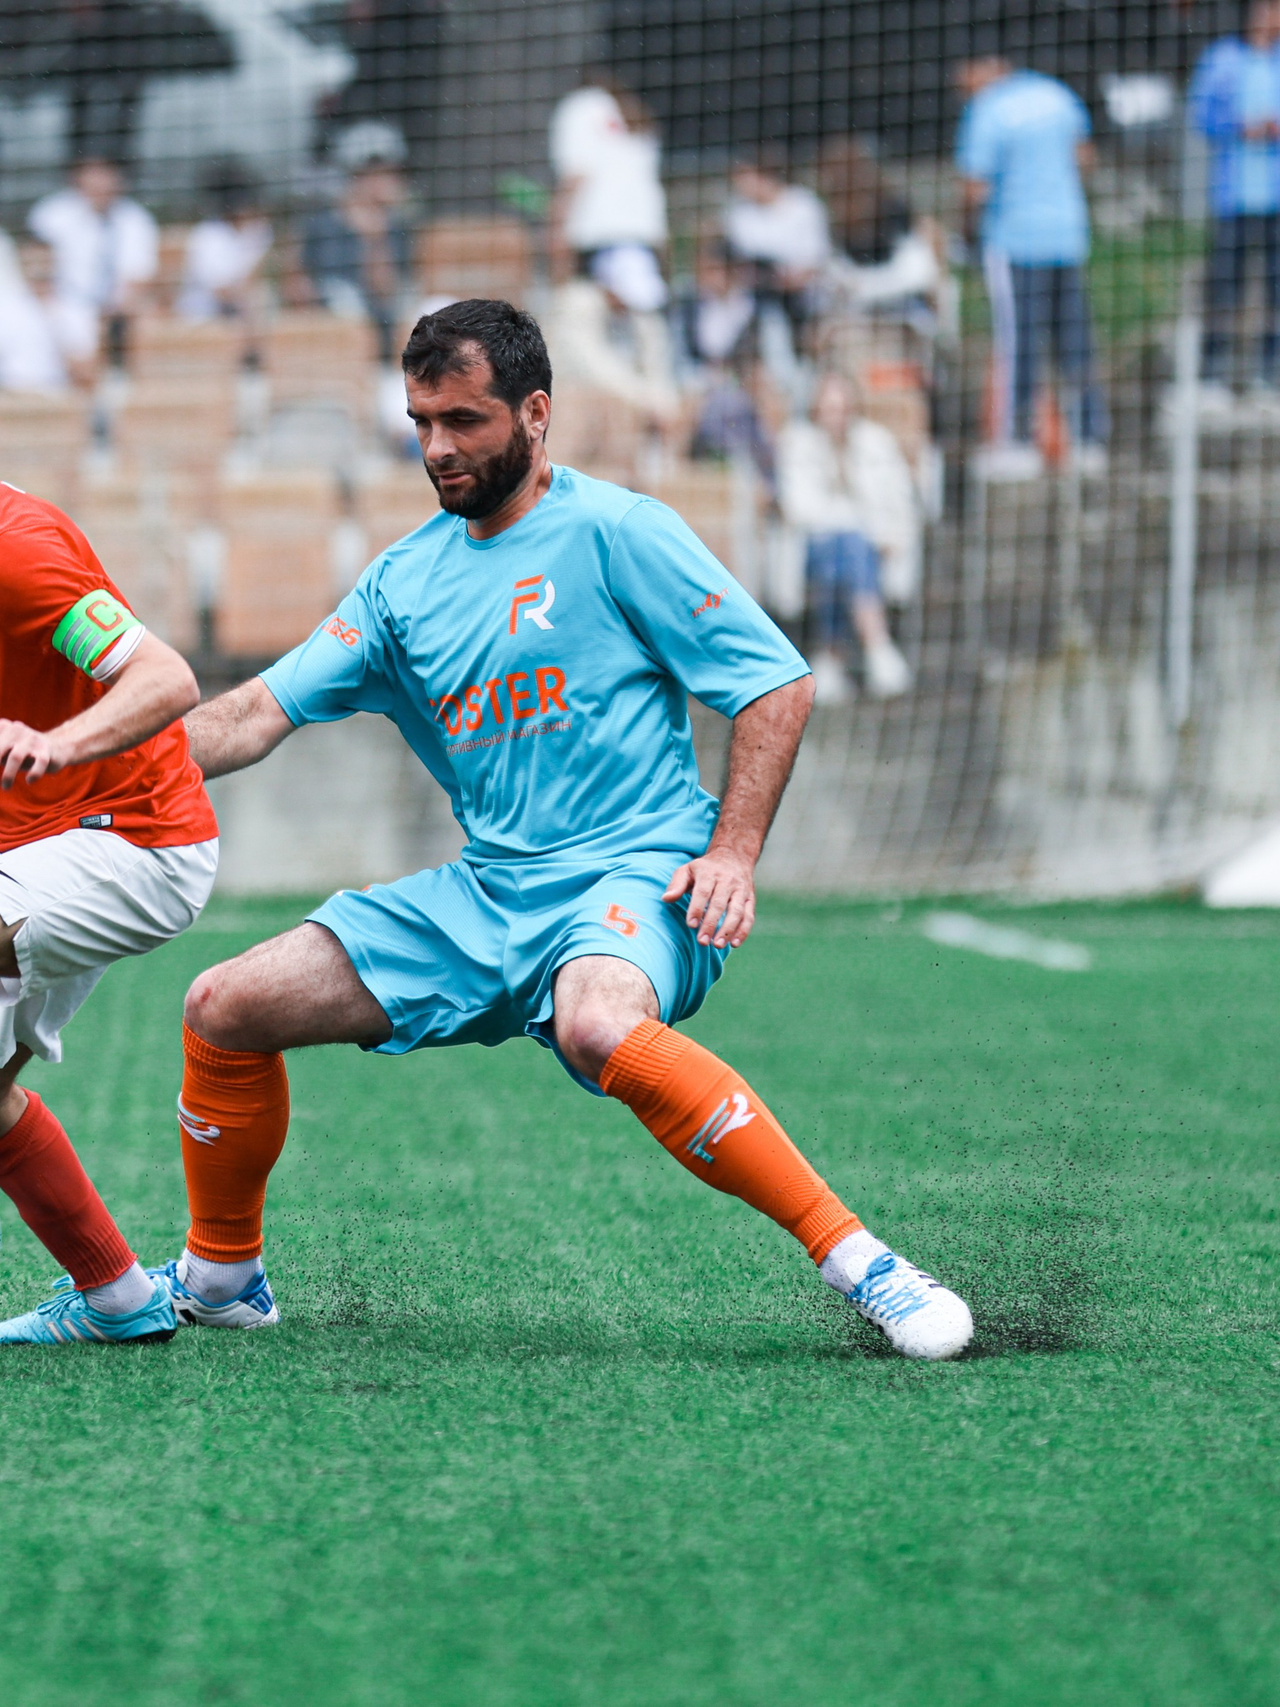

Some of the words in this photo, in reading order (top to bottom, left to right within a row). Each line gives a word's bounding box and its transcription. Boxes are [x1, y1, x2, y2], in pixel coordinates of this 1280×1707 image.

[86, 600, 123, 632] C
[429, 667, 569, 736] OSTER
[602, 903, 642, 938] 5
